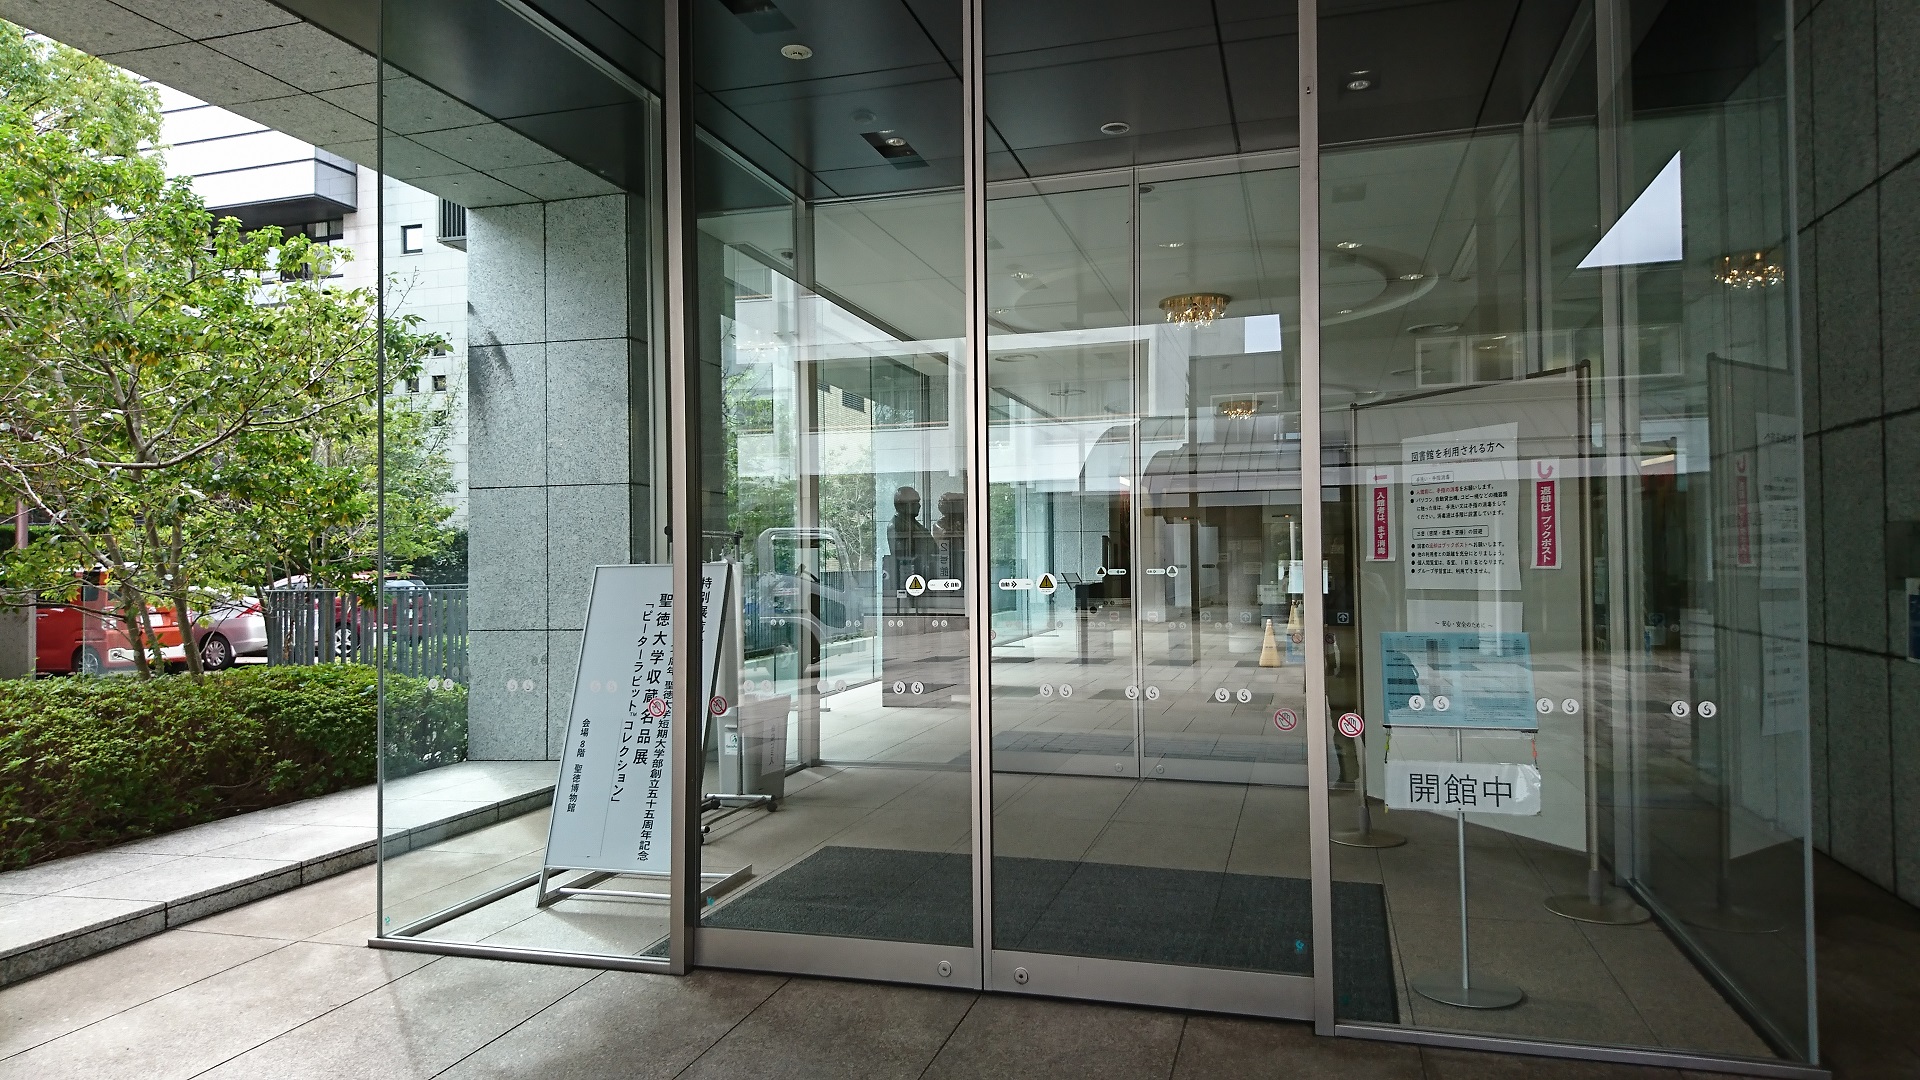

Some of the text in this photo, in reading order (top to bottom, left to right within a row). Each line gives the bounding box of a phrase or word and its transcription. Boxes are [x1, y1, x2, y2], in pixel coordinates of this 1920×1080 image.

[1411, 442, 1505, 462] 図書館を利用される方へ
[1376, 491, 1386, 555] 入館者は、まず消毒
[1541, 486, 1552, 563] 返却は ブックポスト
[632, 592, 674, 766] 聖徳大学収蔵名品展
[579, 718, 591, 738] 会場
[566, 763, 583, 813] 聖徳博物館
[1408, 773, 1512, 808] 開館中
